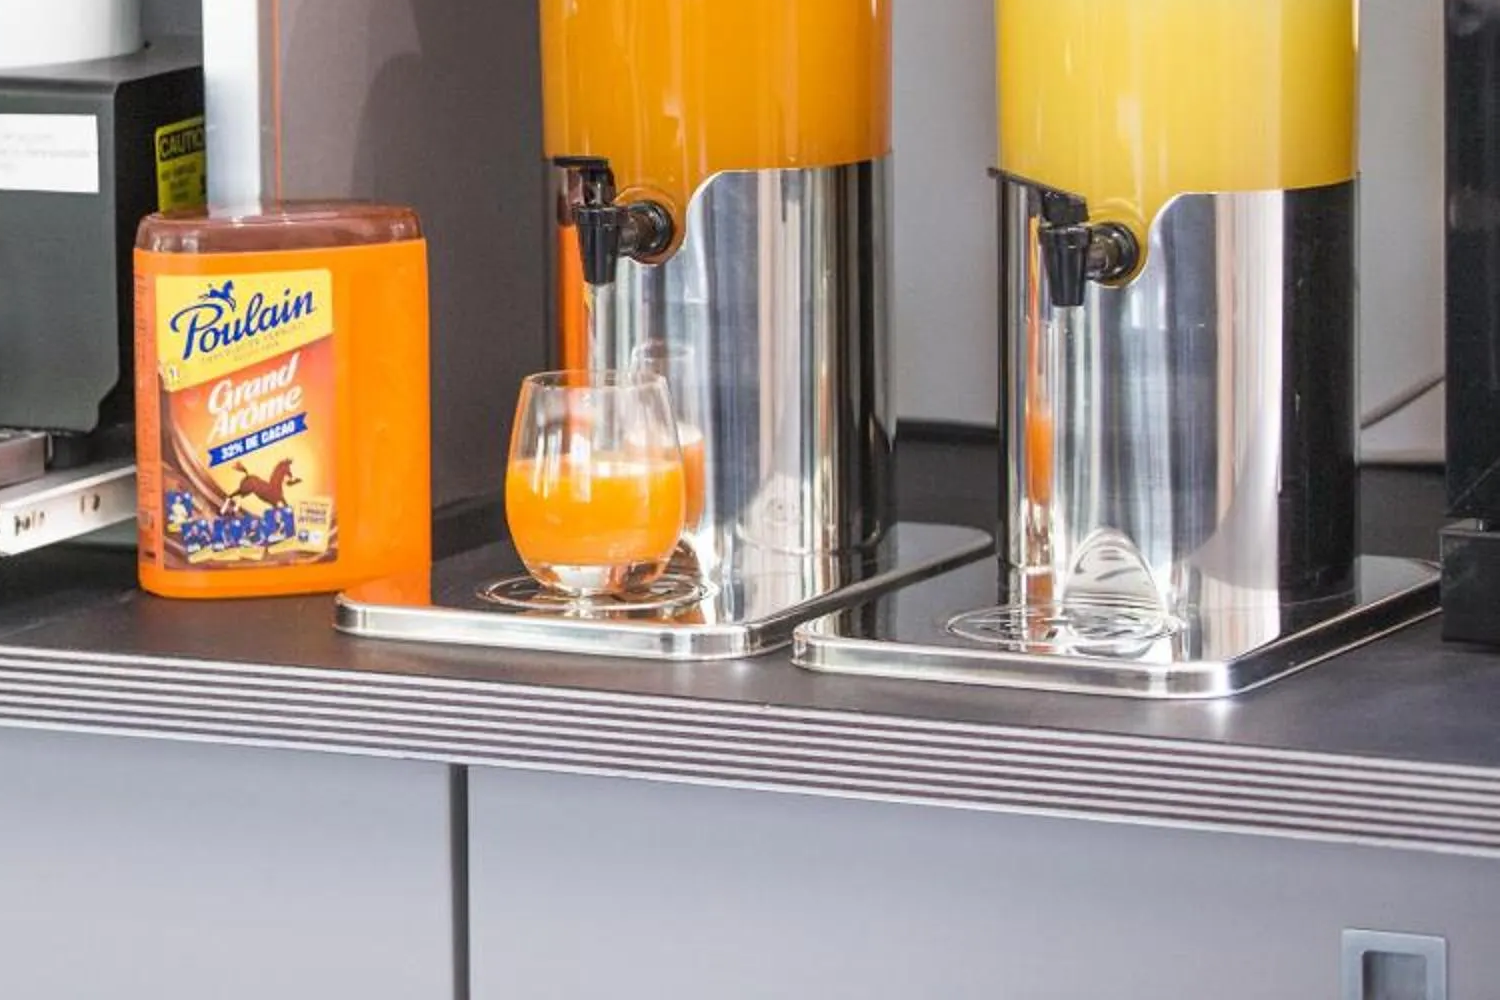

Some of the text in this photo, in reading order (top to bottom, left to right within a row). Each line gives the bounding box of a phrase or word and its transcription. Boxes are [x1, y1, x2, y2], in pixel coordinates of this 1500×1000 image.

[160, 128, 205, 158] CAUTIO
[169, 288, 316, 361] Poulain
[208, 351, 300, 413] Grand
[245, 434, 260, 451] DE
[261, 419, 296, 445] CACAO
